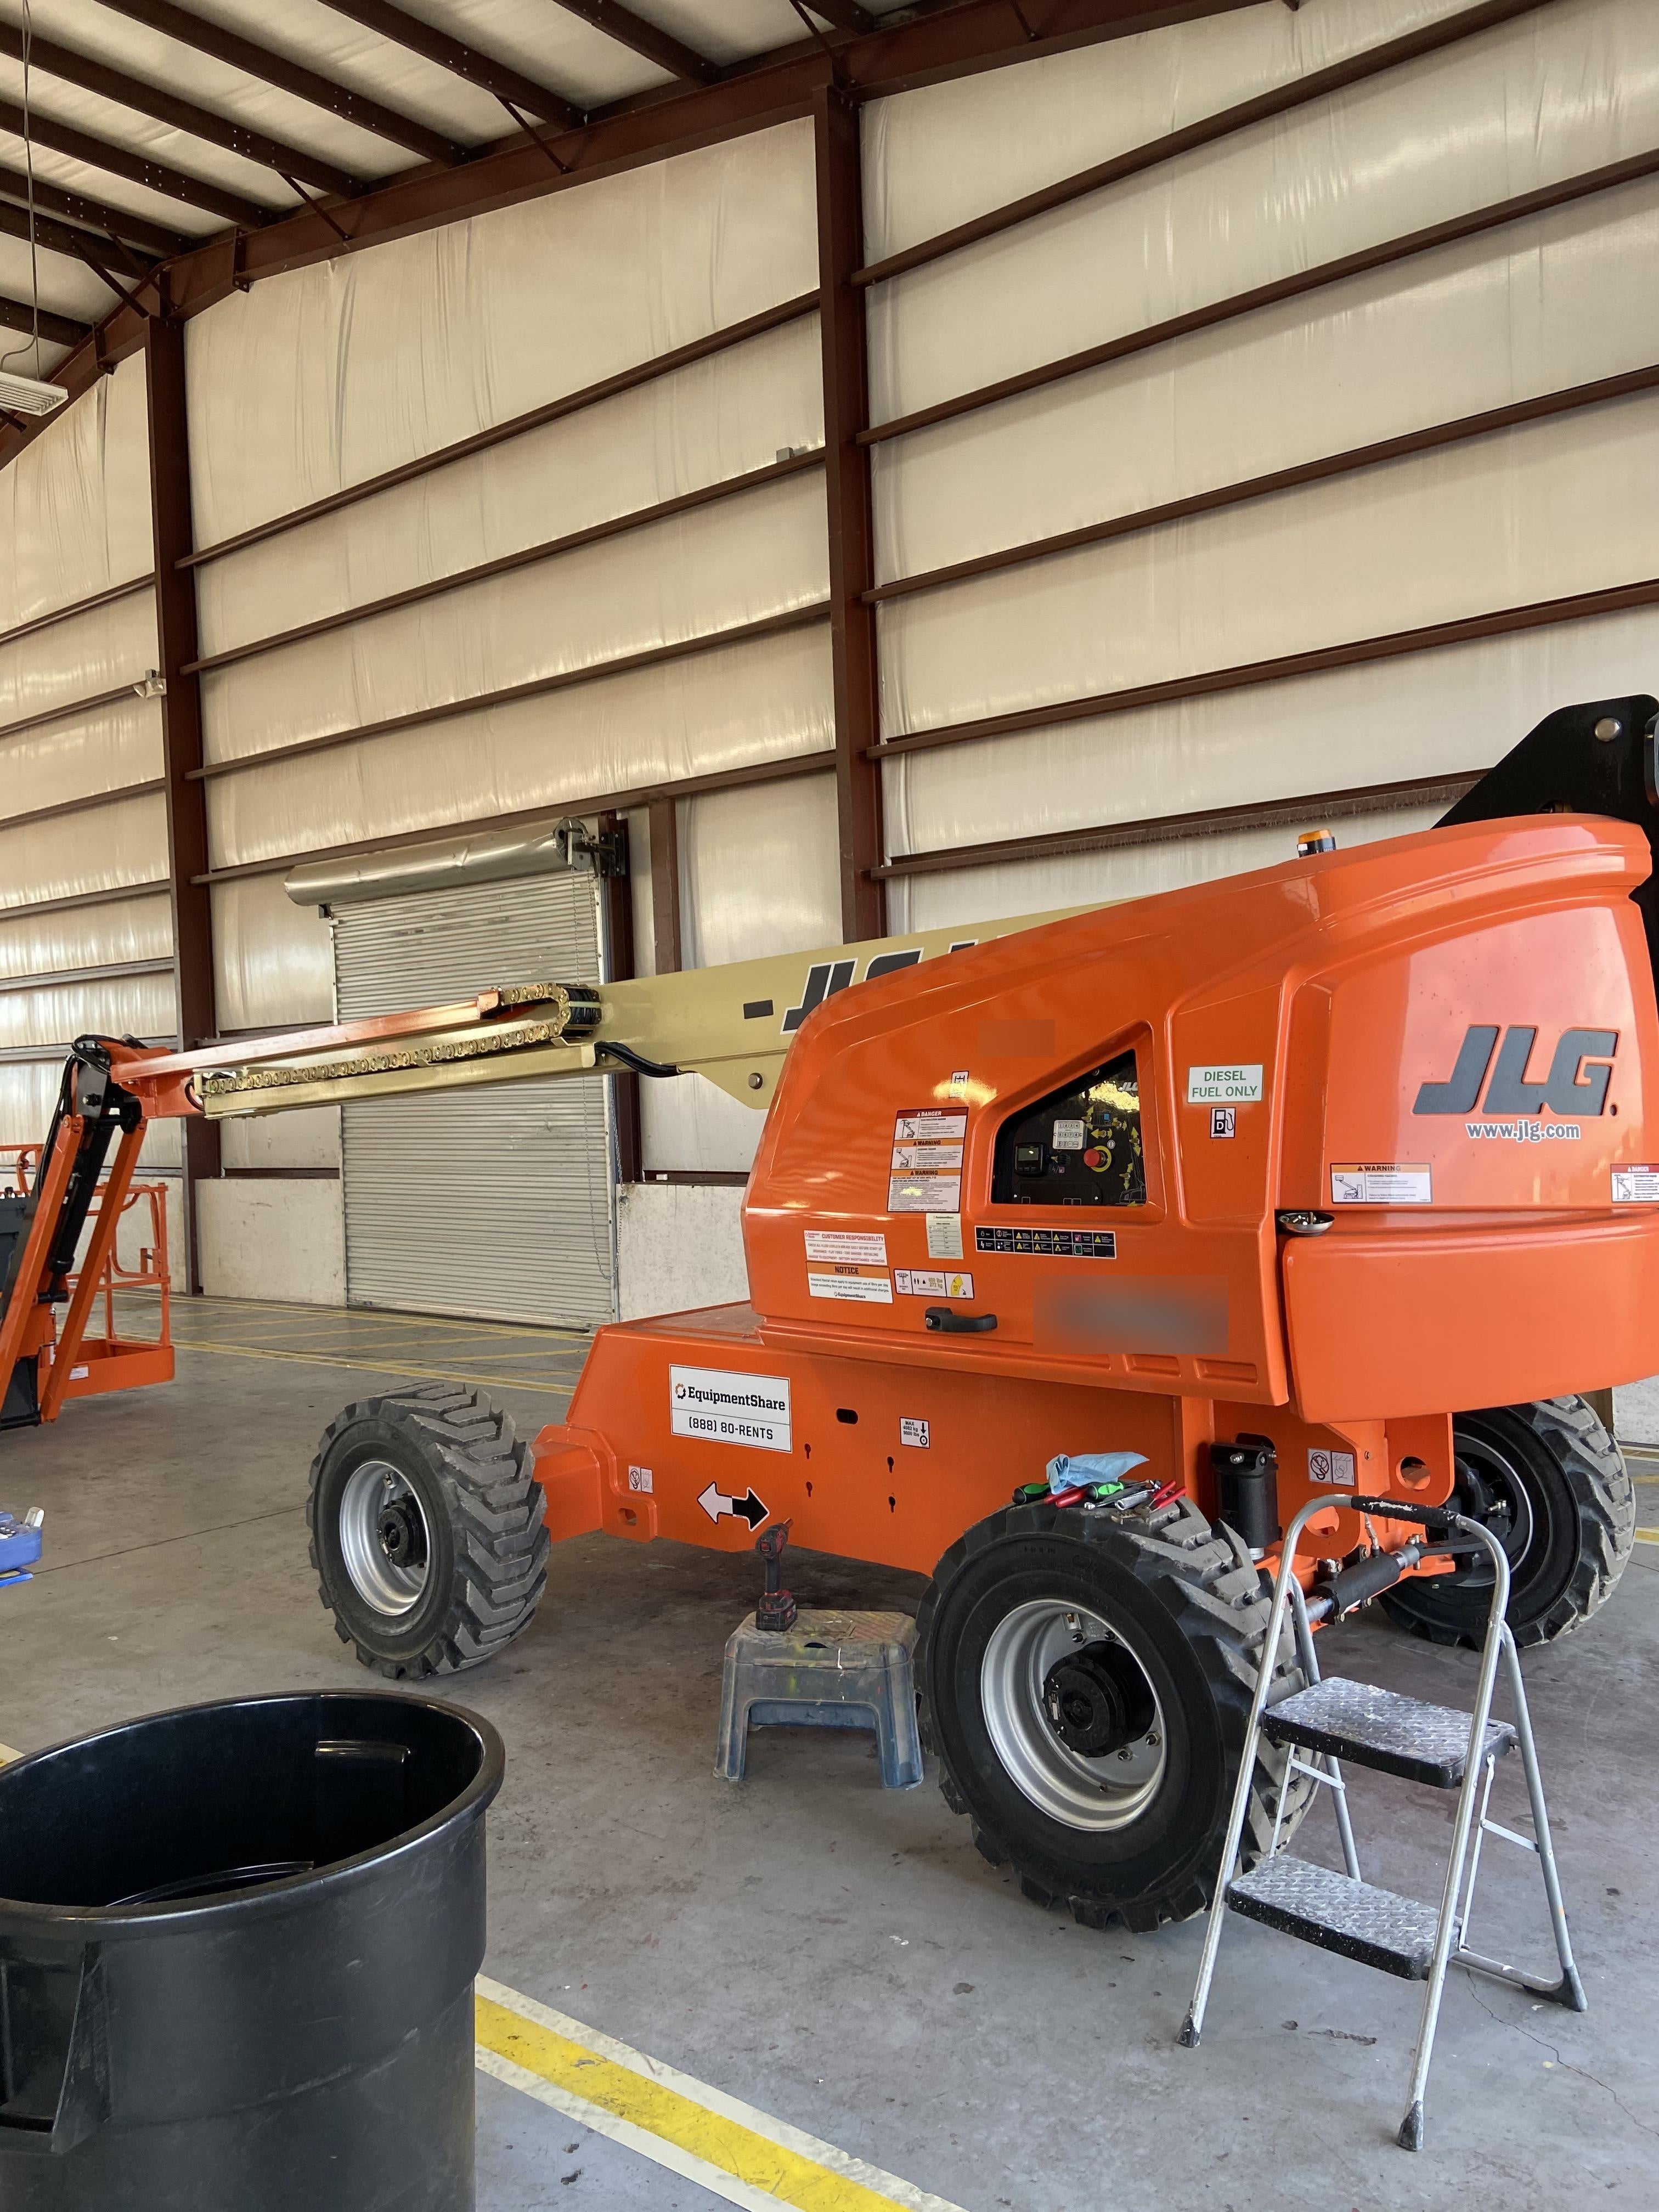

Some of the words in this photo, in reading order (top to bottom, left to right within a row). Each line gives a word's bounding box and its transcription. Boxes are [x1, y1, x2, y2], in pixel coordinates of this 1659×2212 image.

[1204, 1071, 1246, 1081] DIESEL
[1413, 1025, 1618, 1116] JLG
[1192, 1087, 1222, 1097] FUEL
[1226, 1086, 1257, 1096] ONLY
[1216, 1121, 1224, 1130] D
[1466, 1120, 1579, 1142] www.jlg.com
[835, 1266, 859, 1274] NOTICE
[688, 1386, 786, 1410] EquipmentShare
[689, 1417, 716, 1432] (888)
[721, 1422, 773, 1440] 80-RENTS
